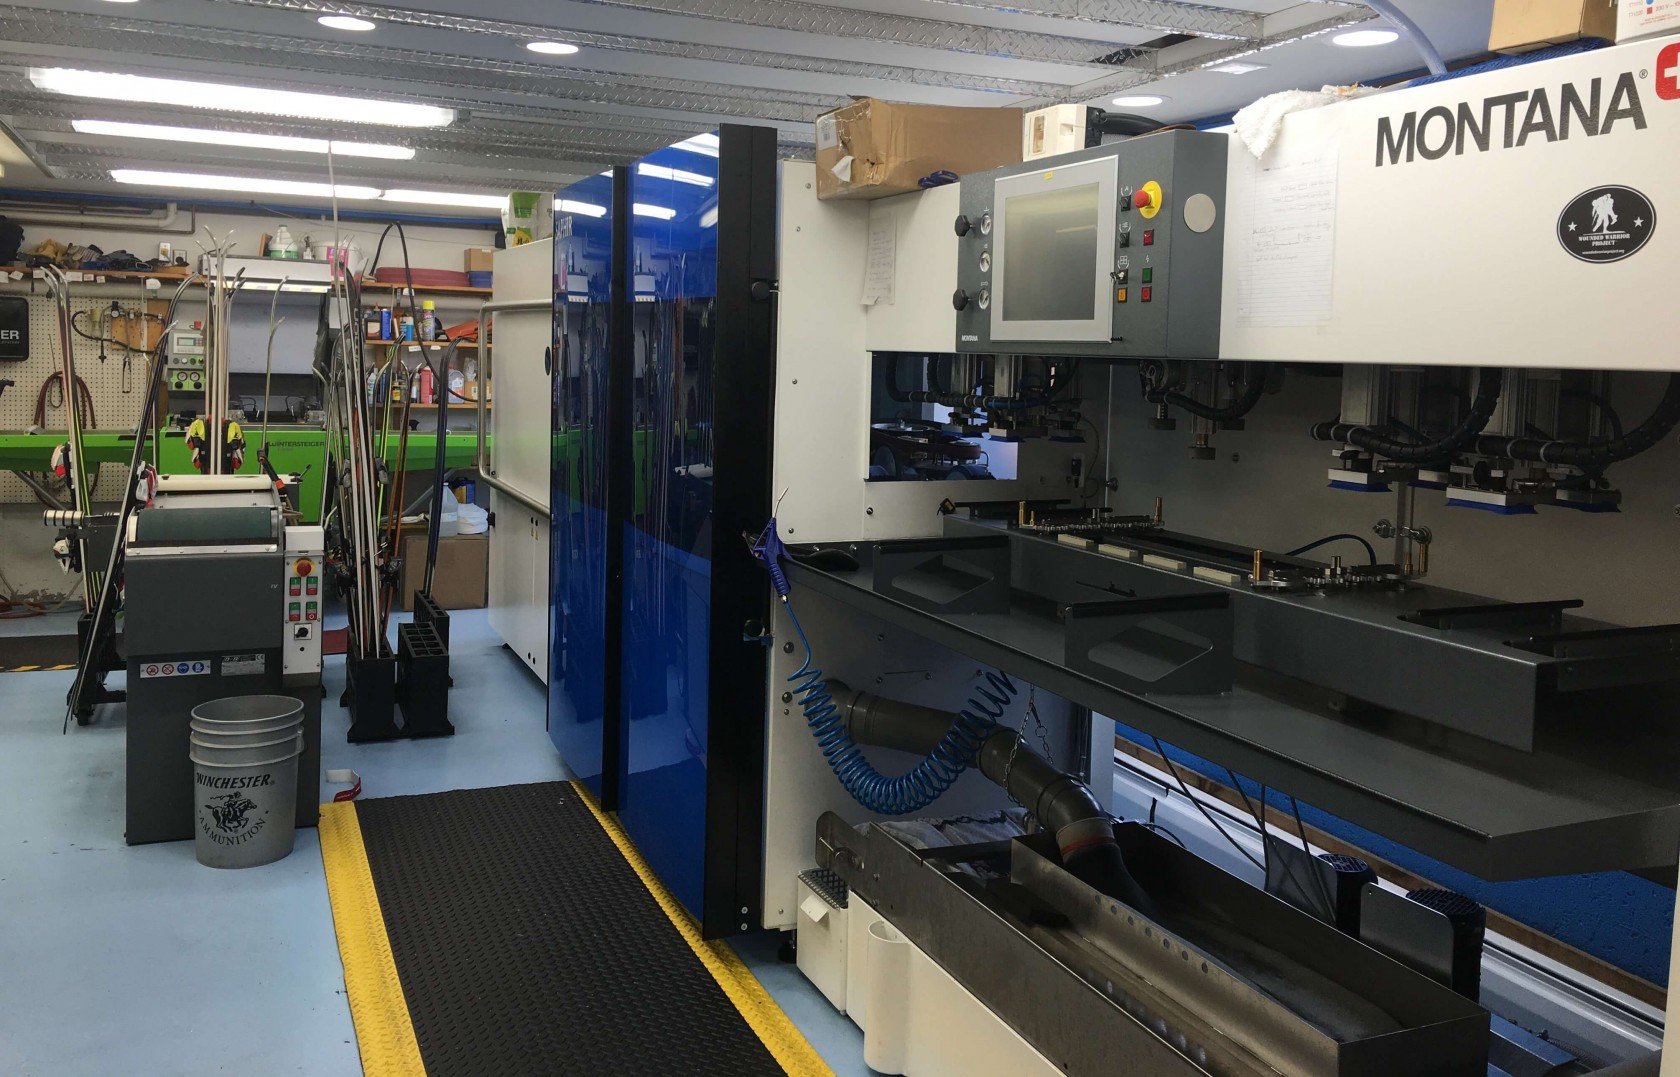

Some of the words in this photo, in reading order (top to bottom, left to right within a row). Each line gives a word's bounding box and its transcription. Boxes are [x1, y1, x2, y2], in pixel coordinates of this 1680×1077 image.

[1375, 71, 1648, 167] MONTANA
[196, 772, 271, 790] WINCHESTER
[200, 817, 267, 846] AMMUNITION
